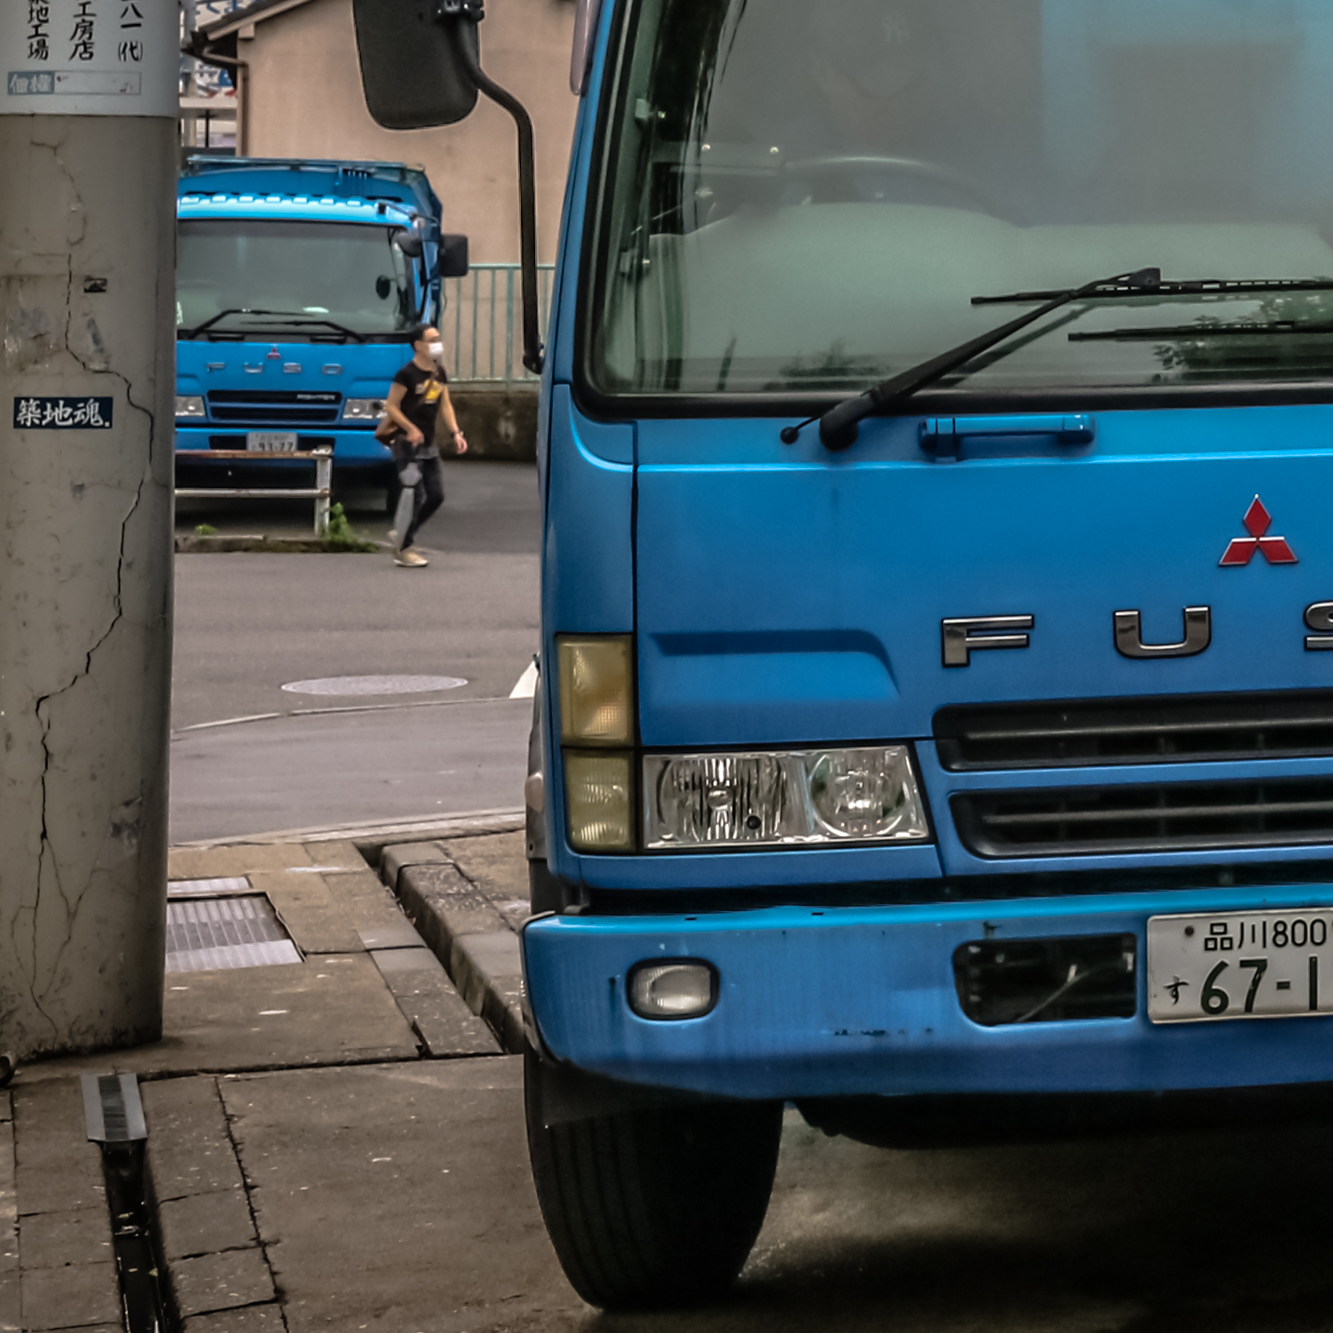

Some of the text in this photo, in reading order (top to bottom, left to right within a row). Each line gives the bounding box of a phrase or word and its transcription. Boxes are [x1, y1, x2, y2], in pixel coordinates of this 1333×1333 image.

[206, 362, 344, 375] FUSO
[1204, 918, 1327, 952] 品川800
[1164, 975, 1190, 1006] す
